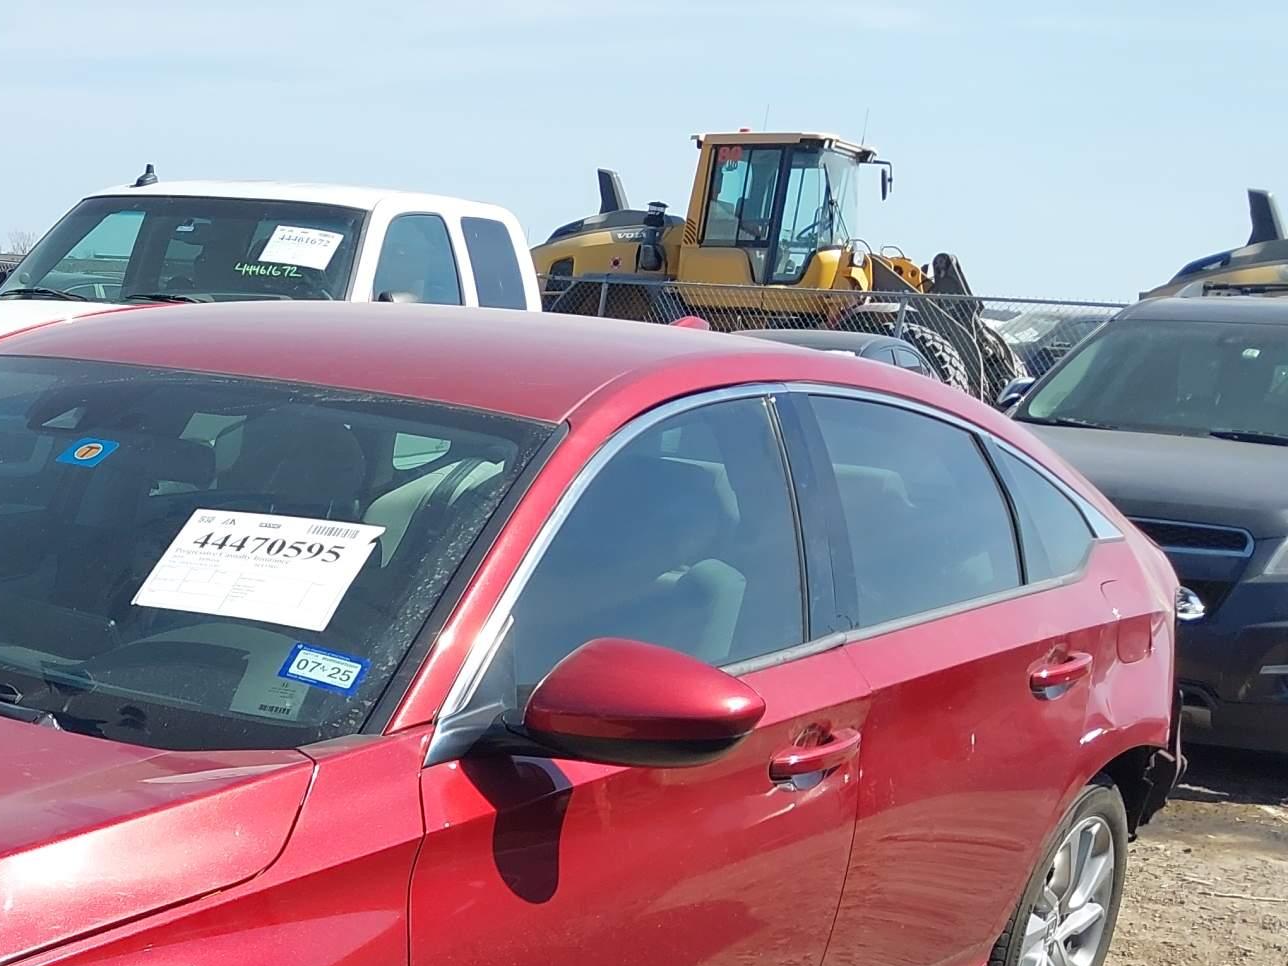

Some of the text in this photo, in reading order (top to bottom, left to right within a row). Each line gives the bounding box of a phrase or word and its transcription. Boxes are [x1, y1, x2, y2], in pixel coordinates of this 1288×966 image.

[234, 262, 302, 277] 44461672
[193, 531, 345, 564] 44470595
[296, 658, 322, 673] 07
[327, 666, 353, 682] 25
